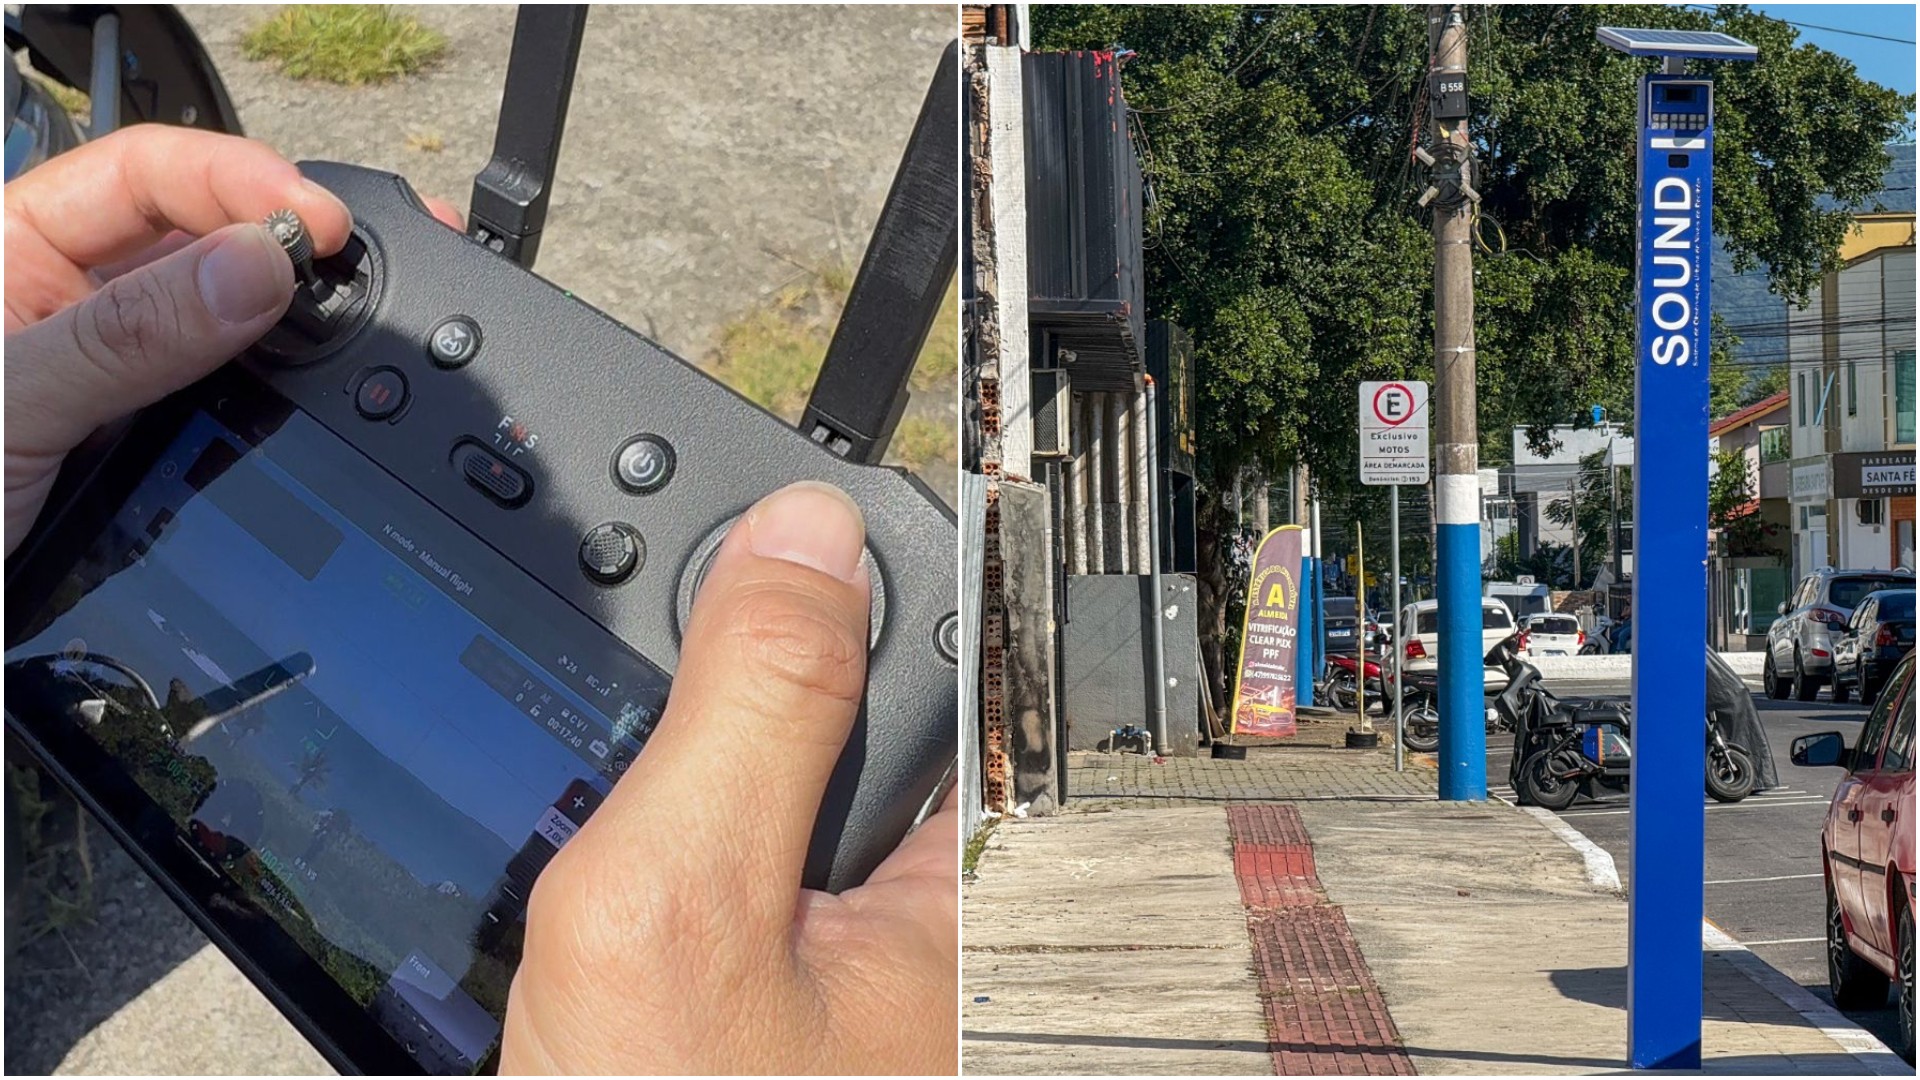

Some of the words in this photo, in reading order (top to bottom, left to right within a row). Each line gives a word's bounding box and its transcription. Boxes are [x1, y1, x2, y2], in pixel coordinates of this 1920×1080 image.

[1440, 83, 1448, 93] B
[1448, 82, 1464, 92] 558
[1652, 177, 1690, 366] SOUND
[1387, 393, 1401, 416] E
[498, 415, 514, 428] F
[525, 434, 538, 448] S
[1866, 471, 1900, 482] SANTA
[1904, 468, 1916, 481] FÉ
[382, 524, 393, 534] N
[390, 530, 414, 552] mode
[418, 550, 452, 578] Manual
[449, 573, 474, 596] flight
[1266, 583, 1284, 608] A
[1248, 622, 1296, 637] VITRIFICAÇÃO
[1250, 635, 1275, 646] CLEAR
[1263, 648, 1280, 659] PPF
[566, 662, 578, 674] 26
[585, 674, 600, 688] RC
[547, 717, 583, 748] 00:17:40
[550, 814, 573, 836] Zoom
[408, 955, 430, 978] Front
